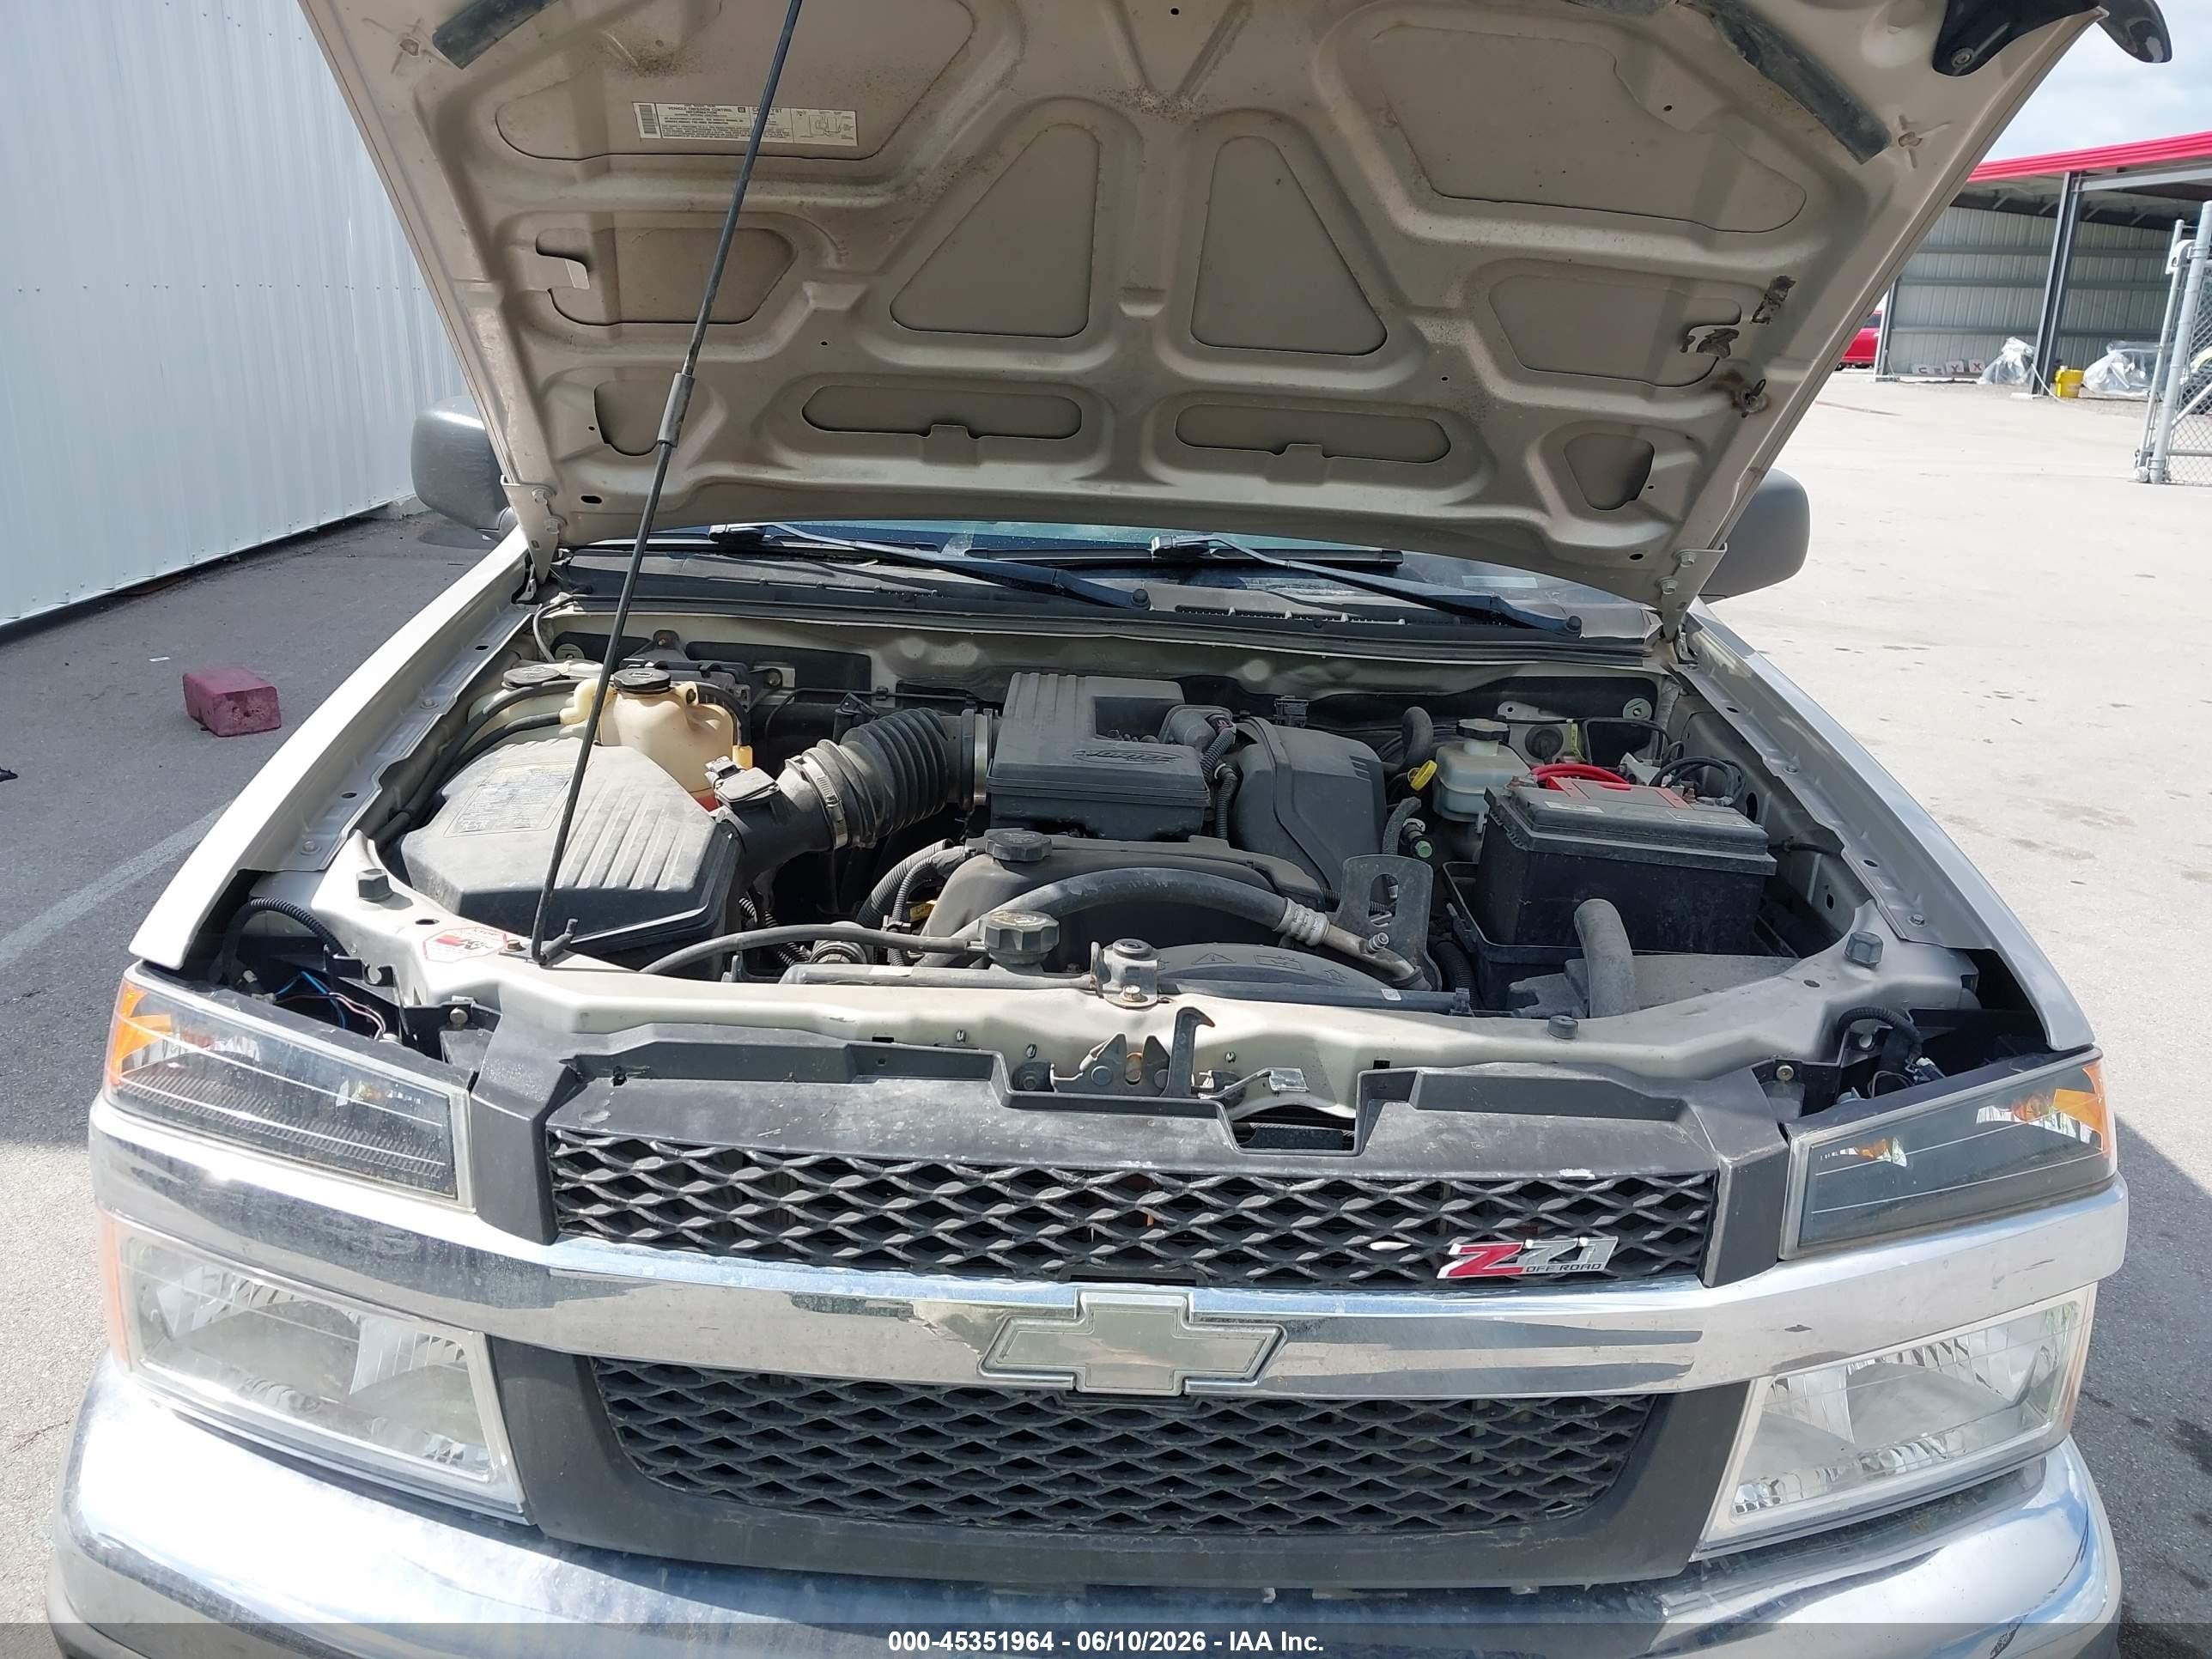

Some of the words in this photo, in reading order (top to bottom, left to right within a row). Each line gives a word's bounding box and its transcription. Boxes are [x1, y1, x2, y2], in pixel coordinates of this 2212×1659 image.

[1437, 1236, 1617, 1279] Z71
[1525, 1265, 1556, 1273] OFF
[1559, 1263, 1602, 1273] ROAD
